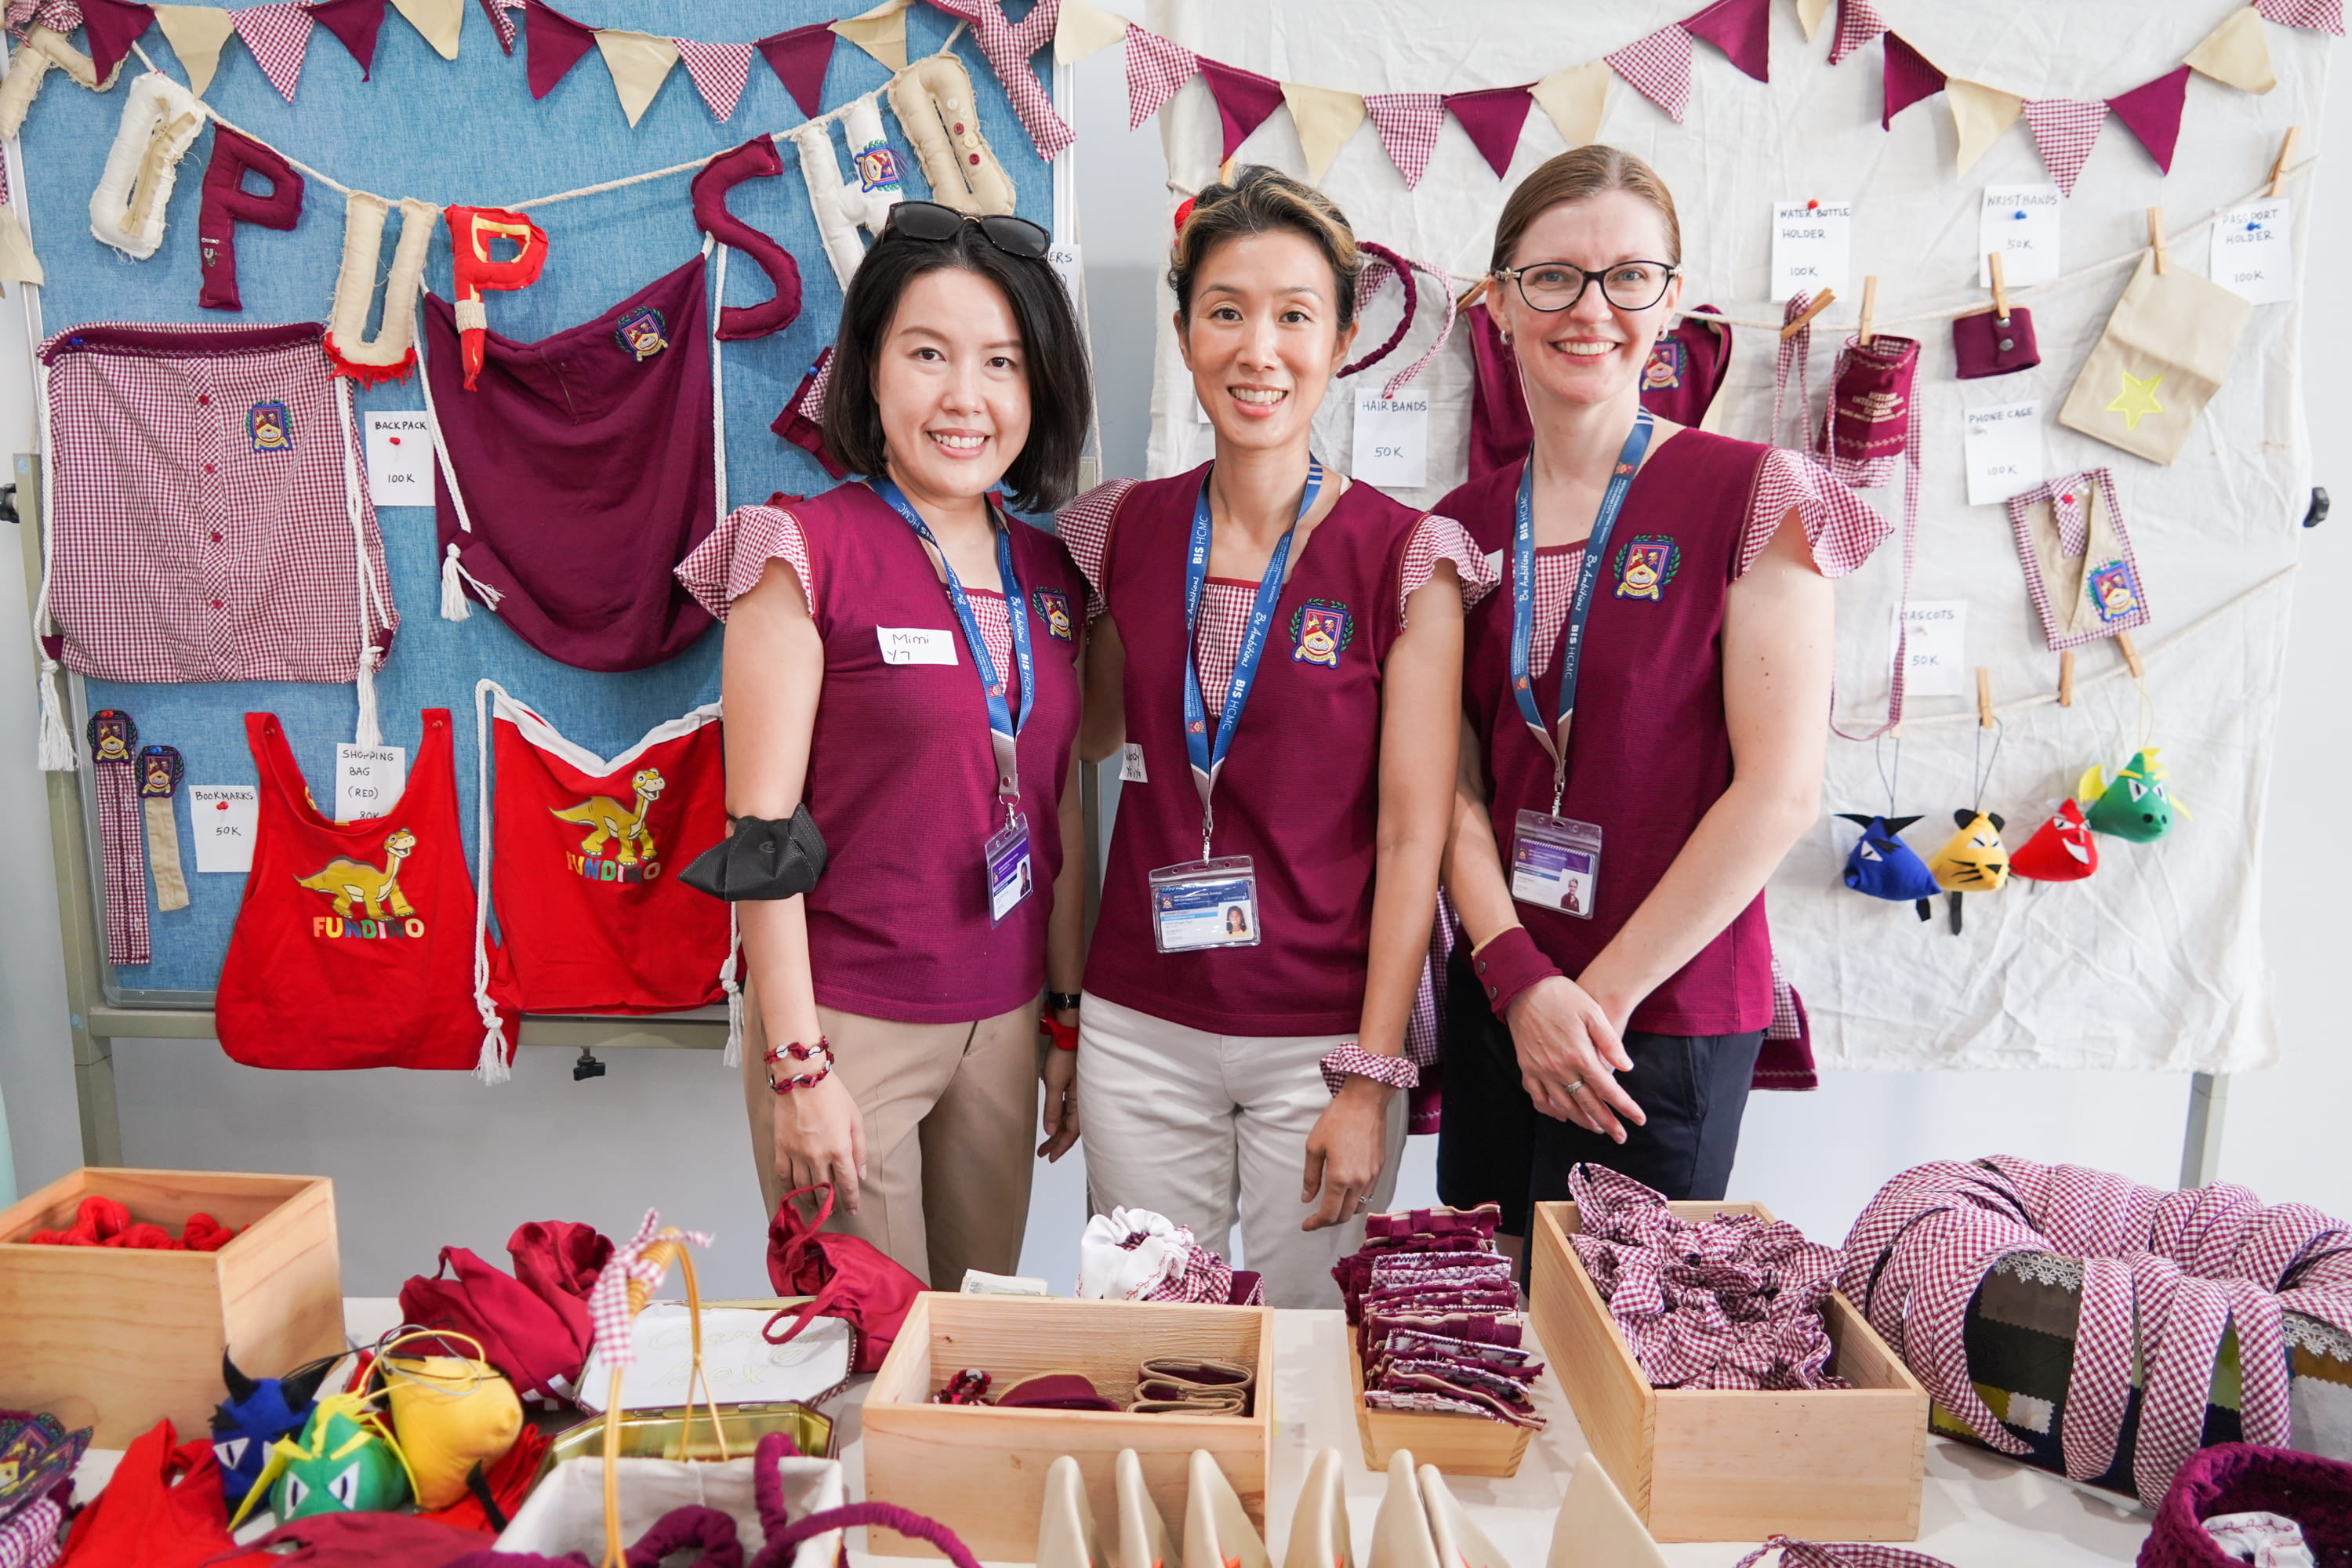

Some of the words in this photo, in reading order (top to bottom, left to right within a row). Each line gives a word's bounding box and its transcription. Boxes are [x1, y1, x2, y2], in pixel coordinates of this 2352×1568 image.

[1780, 209, 1812, 219] WATER
[1817, 208, 1851, 218] BOTTLE
[2223, 209, 2279, 224] PASSPORT
[1782, 228, 1825, 238] HOLDER
[2226, 230, 2274, 245] HOLDER
[1363, 401, 1389, 411] HAIR
[1392, 401, 1427, 412] BANDS
[1969, 411, 2004, 423] PHONE
[2007, 407, 2033, 418] CASE
[1374, 447, 1403, 459] 50K
[388, 474, 415, 483] 100K
[897, 503, 920, 529] HCMC
[1195, 515, 1208, 544] HCMC
[1519, 521, 1529, 541] BIS
[1192, 546, 1204, 564] BIS
[1585, 554, 1598, 568] Be
[1187, 577, 1200, 615] Ambitious
[1575, 569, 1592, 612] Ambitious
[1010, 596, 1021, 607] Be
[1014, 608, 1025, 643] Ambitious
[1254, 612, 1267, 625] Be
[892, 633, 929, 644] Mimi
[1570, 624, 1579, 644] BIS
[1241, 626, 1261, 667] Ambitious
[1021, 652, 1030, 670] BIS
[1564, 647, 1575, 680] HCMC
[1023, 671, 1032, 702] HCMC
[1232, 679, 1246, 699] BIS
[1222, 699, 1240, 731] HCMC
[349, 767, 370, 776] BAG
[195, 791, 253, 800] BOOKMARKS
[348, 786, 379, 800] (RED)
[216, 826, 241, 837] 50K
[313, 916, 425, 939] FUNDINO
